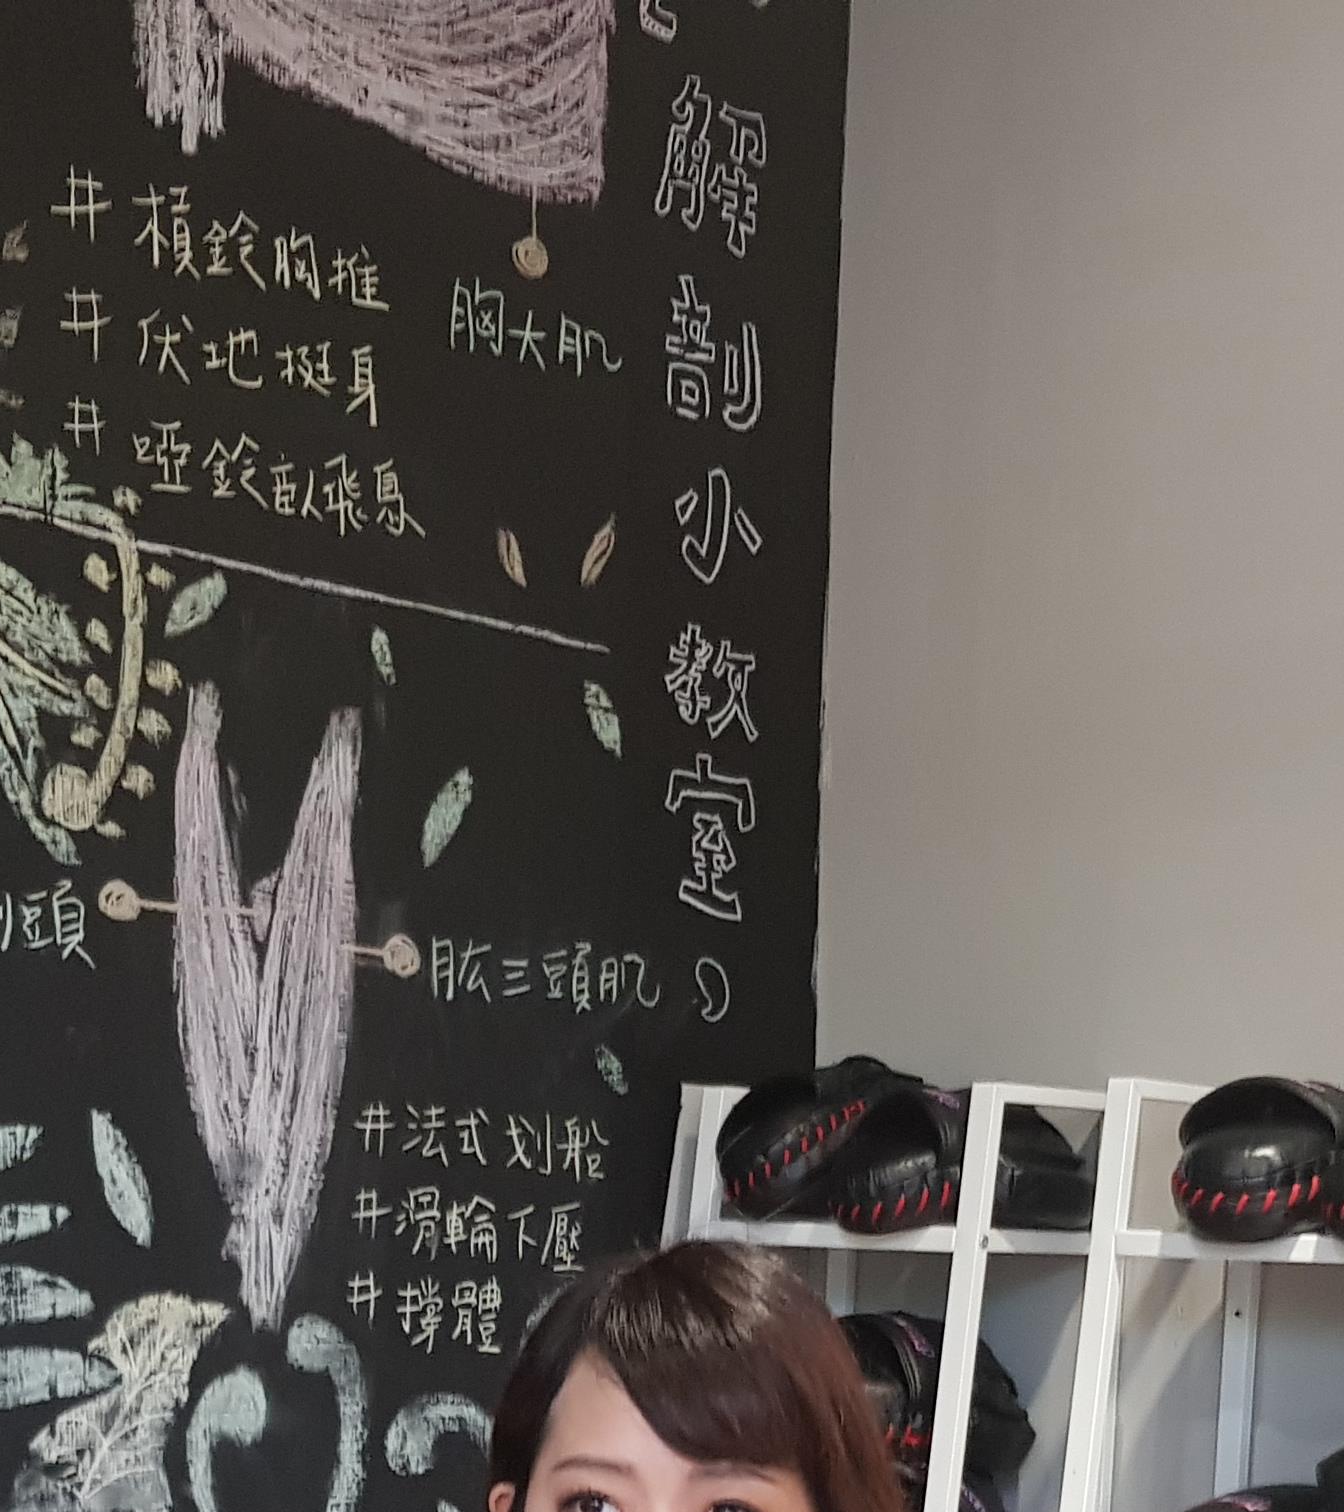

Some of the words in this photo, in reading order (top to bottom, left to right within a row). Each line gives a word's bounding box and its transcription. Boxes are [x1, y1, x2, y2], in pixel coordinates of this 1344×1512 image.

[450, 276, 623, 379] 胸大肌
[430, 935, 662, 1016] 肱三頭肌
